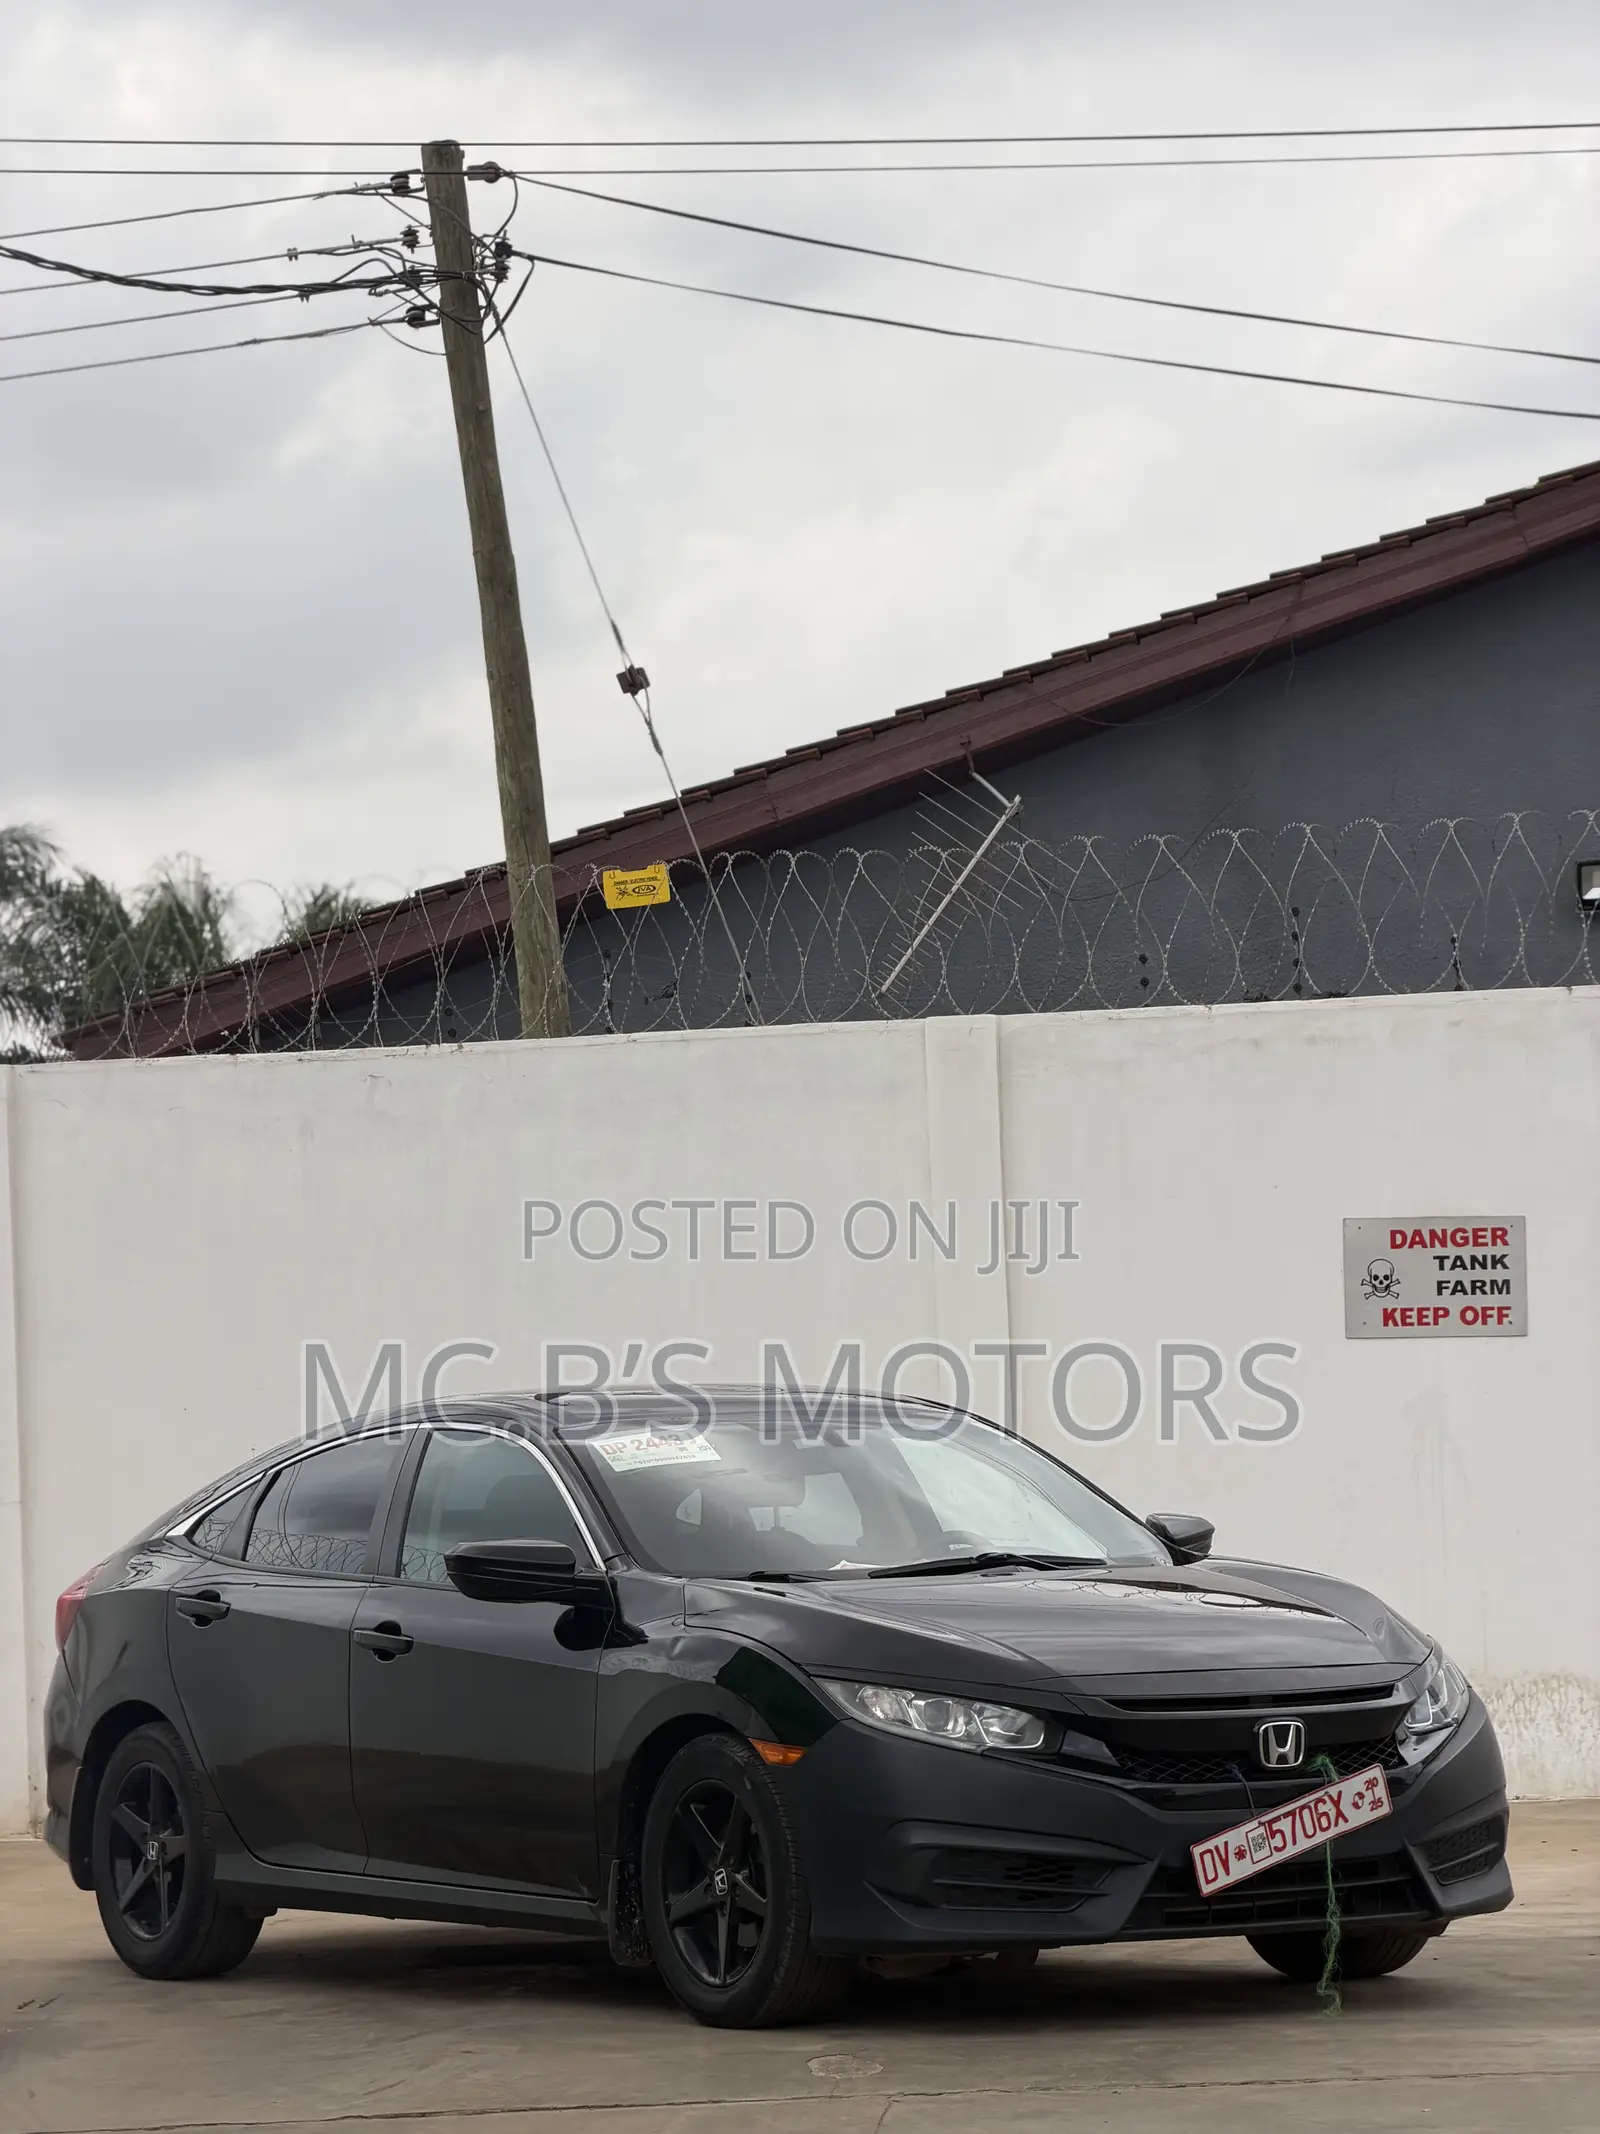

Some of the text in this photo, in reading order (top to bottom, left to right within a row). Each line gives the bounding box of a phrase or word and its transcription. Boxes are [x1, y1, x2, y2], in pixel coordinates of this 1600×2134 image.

[1389, 1227, 1510, 1250] DANGER
[1433, 1253, 1510, 1271] TANK
[1436, 1279, 1511, 1296] FARM
[1382, 1305, 1512, 1327] KEEP OFF
[1199, 1789, 1349, 1885] DV 5706X
